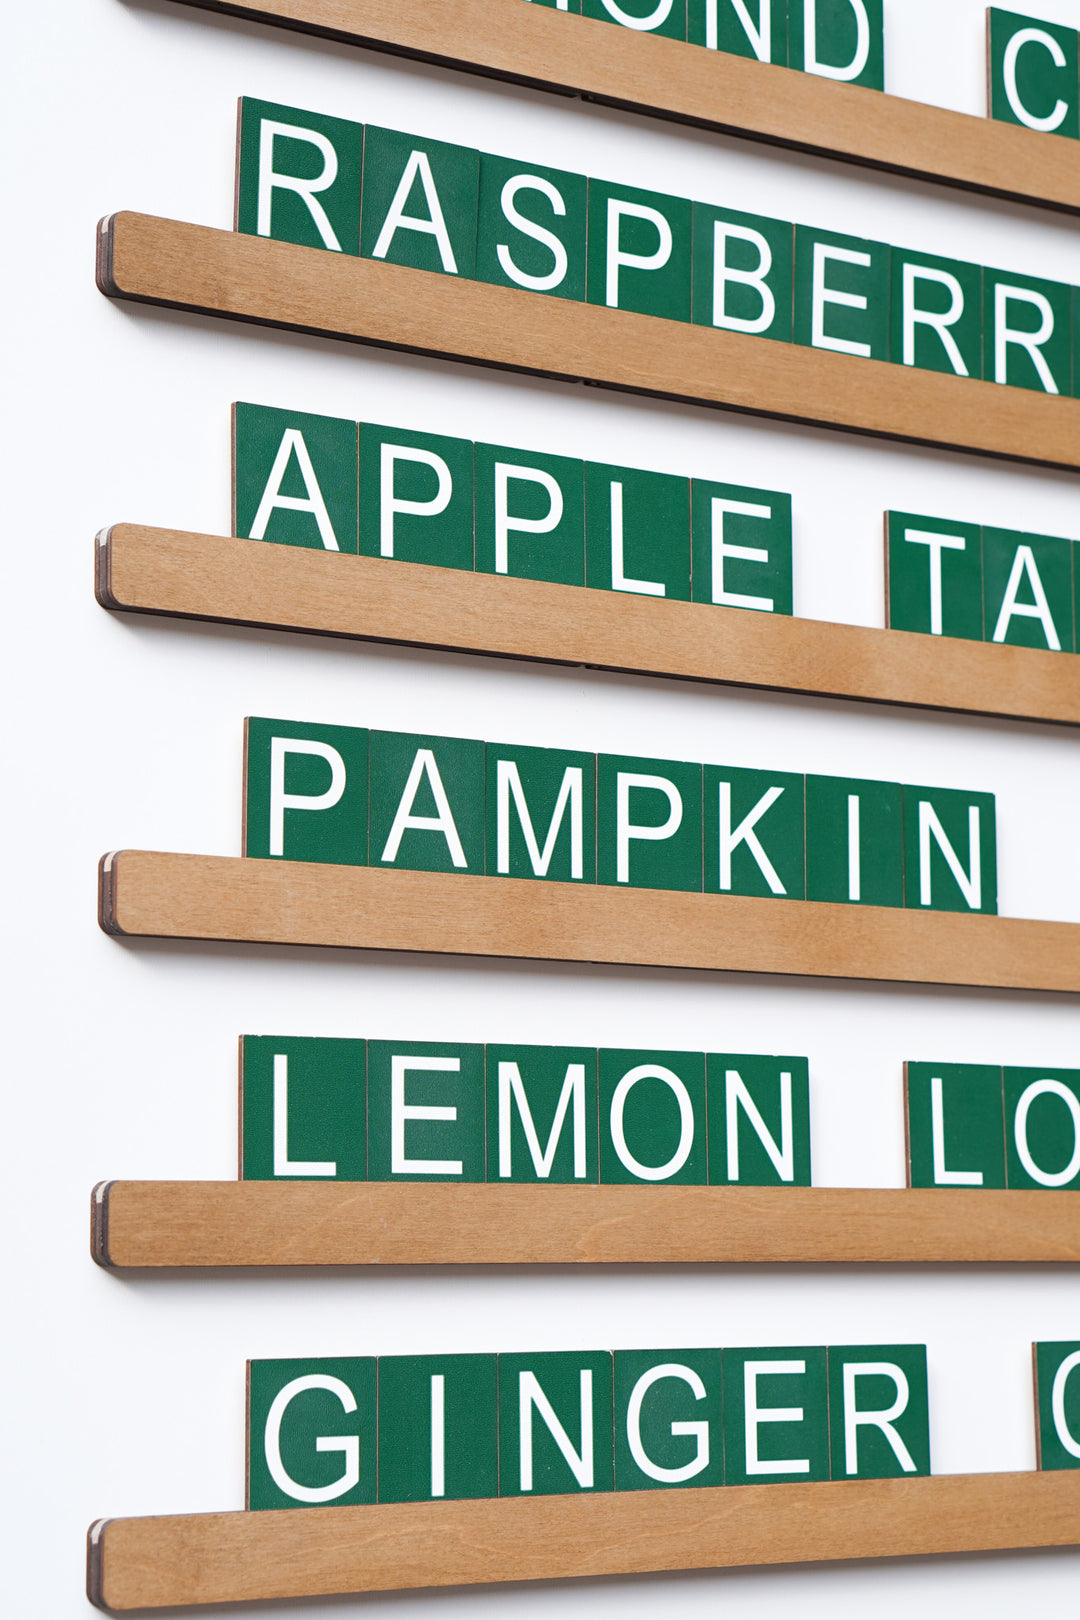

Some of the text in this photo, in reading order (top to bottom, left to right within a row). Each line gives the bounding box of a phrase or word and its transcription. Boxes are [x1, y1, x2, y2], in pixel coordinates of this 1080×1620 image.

[1004, 29, 1067, 131] C
[258, 119, 1058, 395] RASPBERR
[249, 429, 1061, 651] APPLE TA
[270, 737, 982, 910] PAMPKIN
[273, 1055, 1080, 1187] LEMON LO
[264, 1361, 917, 1503] GINGER
